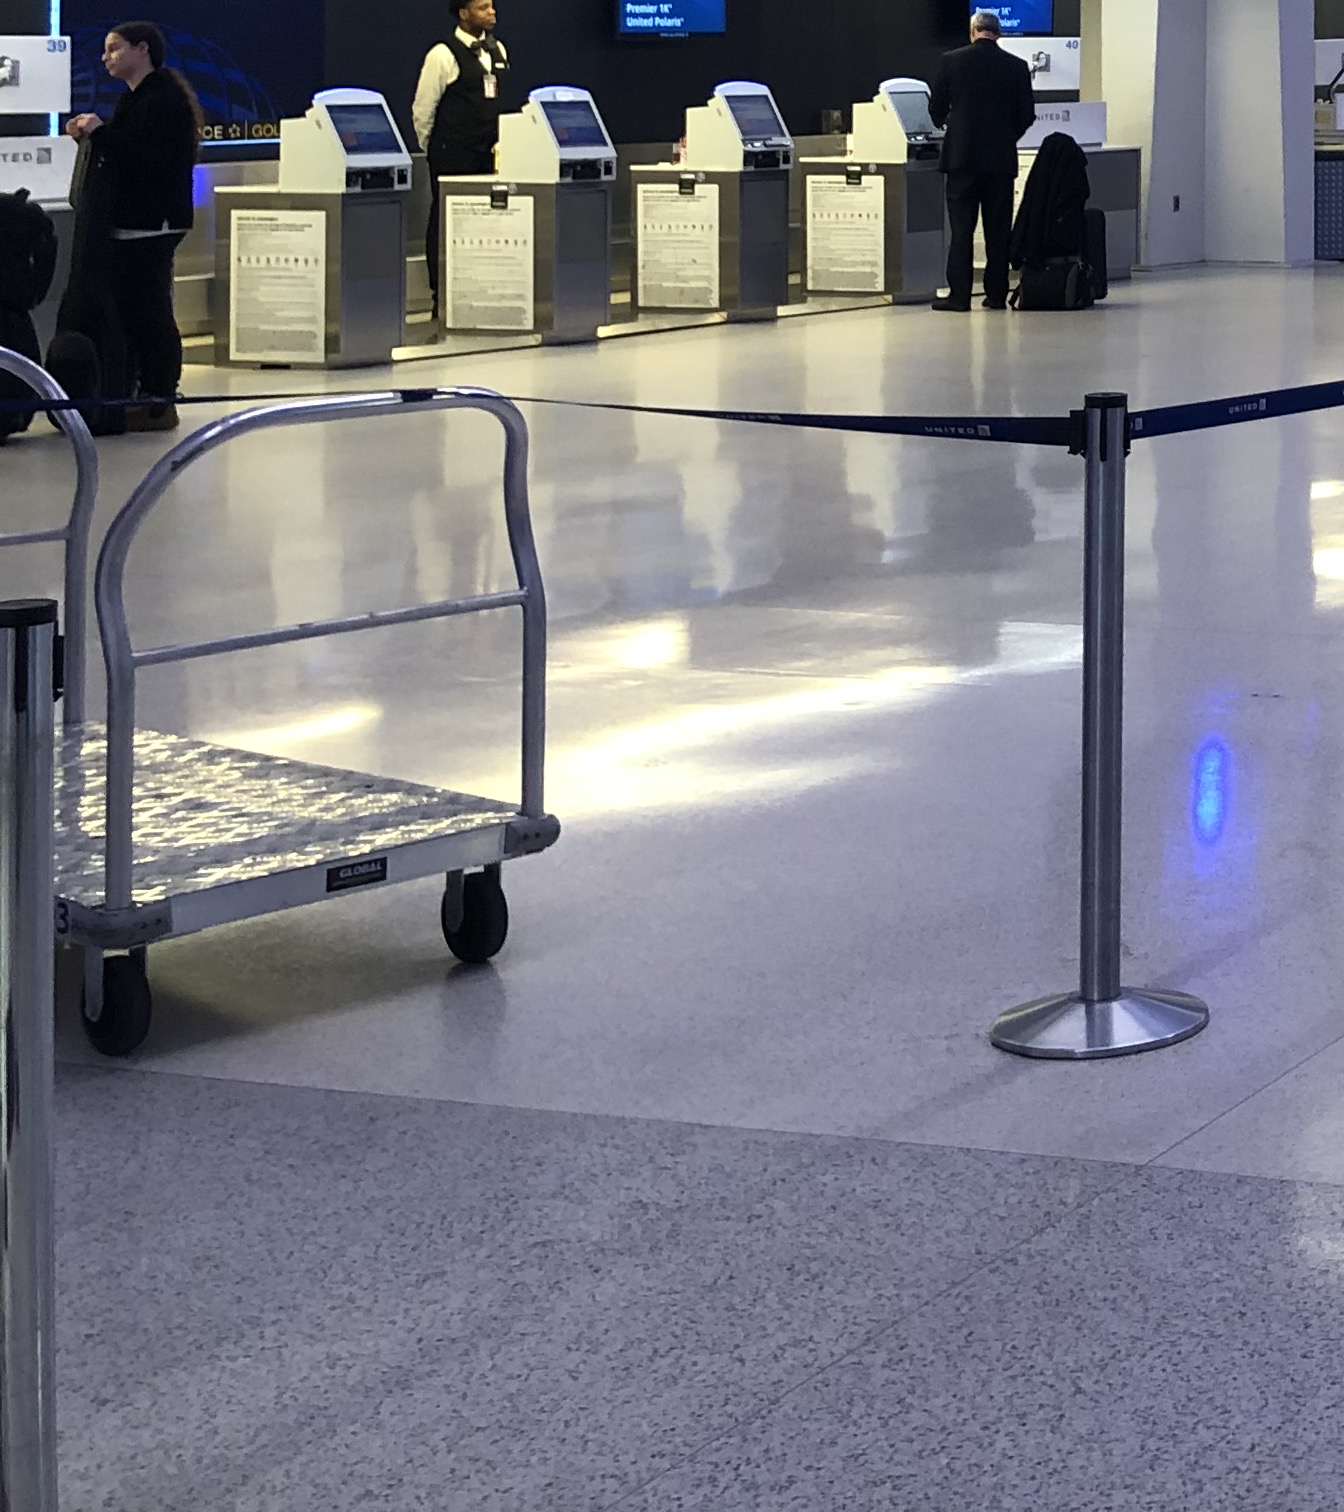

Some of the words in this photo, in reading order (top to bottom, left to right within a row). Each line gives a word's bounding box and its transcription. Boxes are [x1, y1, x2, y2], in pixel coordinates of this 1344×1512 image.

[46, 39, 67, 53] 39
[1065, 40, 1079, 50] 40
[252, 123, 281, 138] GOL
[924, 425, 975, 434] UNITED
[339, 861, 383, 878] GLOBAL
